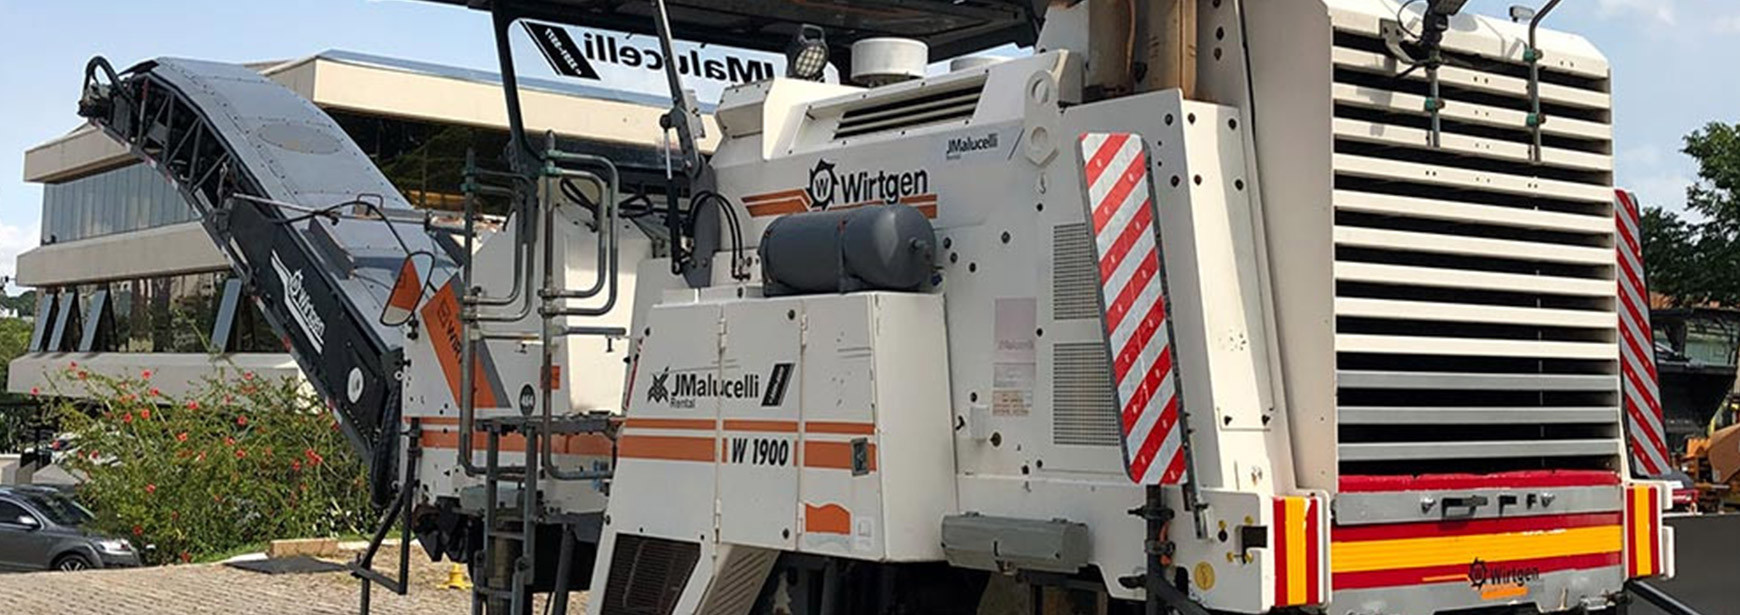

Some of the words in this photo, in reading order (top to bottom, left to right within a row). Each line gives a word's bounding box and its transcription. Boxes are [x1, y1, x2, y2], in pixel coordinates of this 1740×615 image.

[841, 169, 928, 204] Wirtgen
[670, 373, 760, 399] JMalucelli
[732, 438, 748, 463] W
[752, 438, 789, 467] 1900
[1491, 567, 1540, 587] Wirtgen
